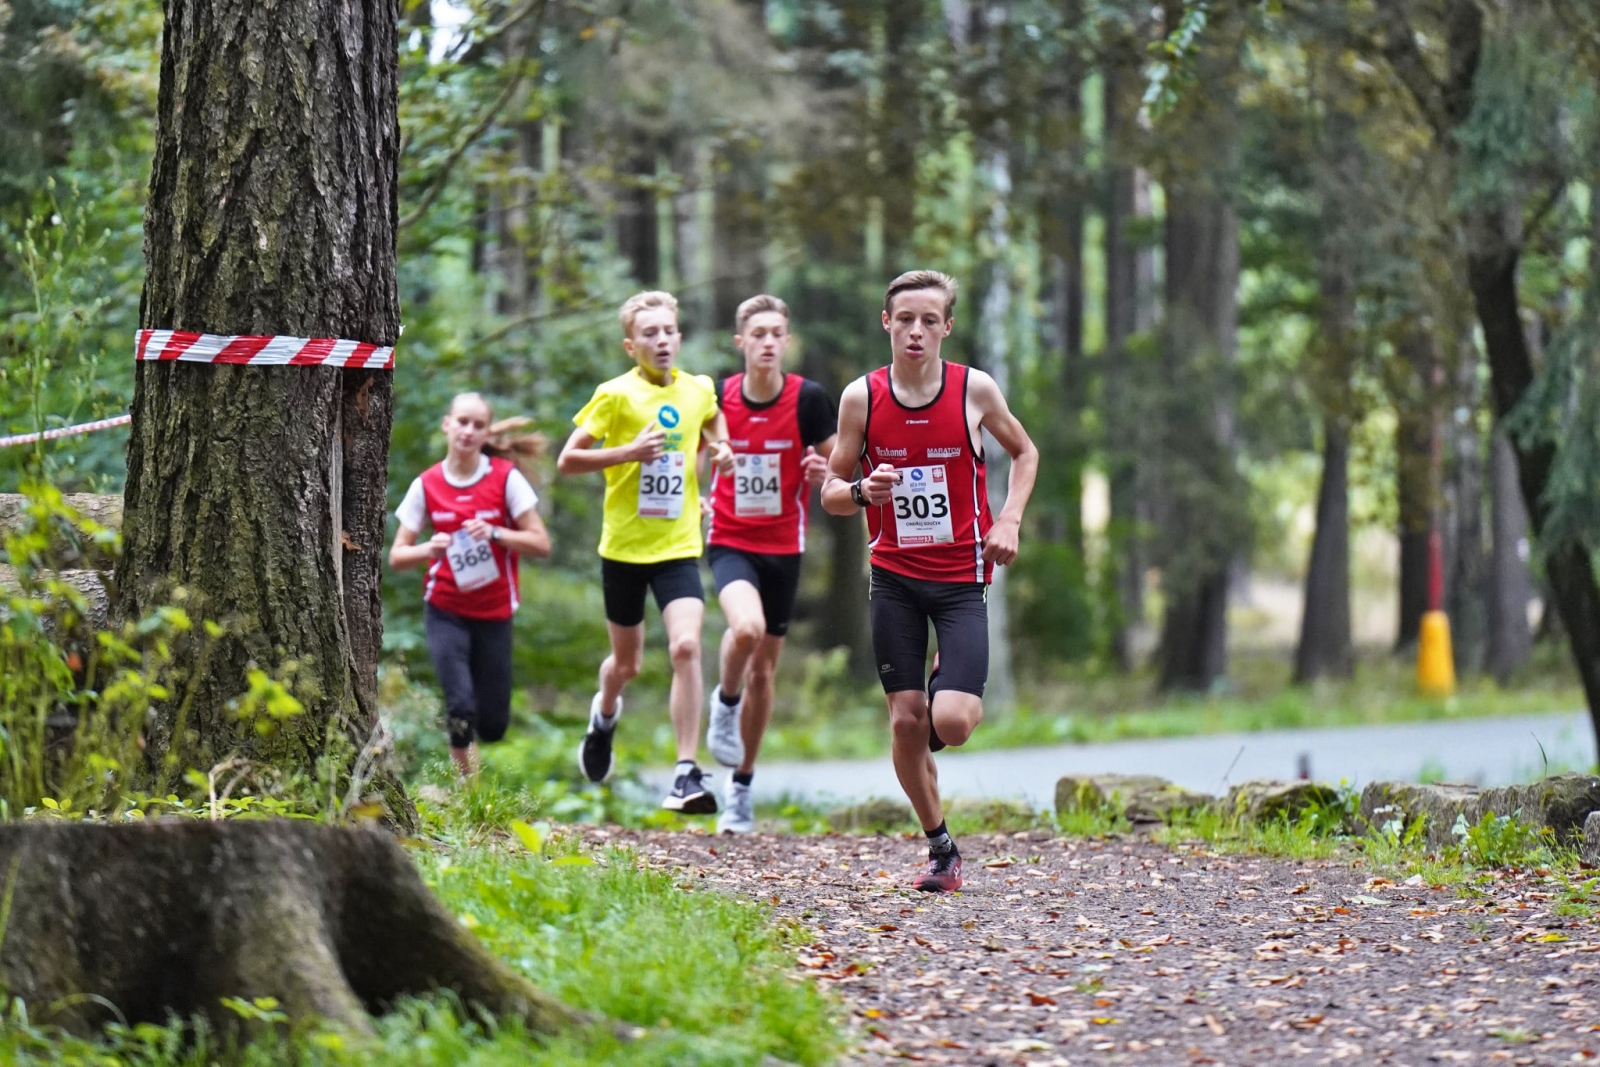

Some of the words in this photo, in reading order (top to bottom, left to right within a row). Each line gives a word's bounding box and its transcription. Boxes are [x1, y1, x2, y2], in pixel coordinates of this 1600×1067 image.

[927, 447, 961, 455] MARATON
[641, 476, 682, 495] 302
[737, 476, 779, 495] 304
[894, 493, 948, 519] 303
[450, 543, 491, 572] 368
